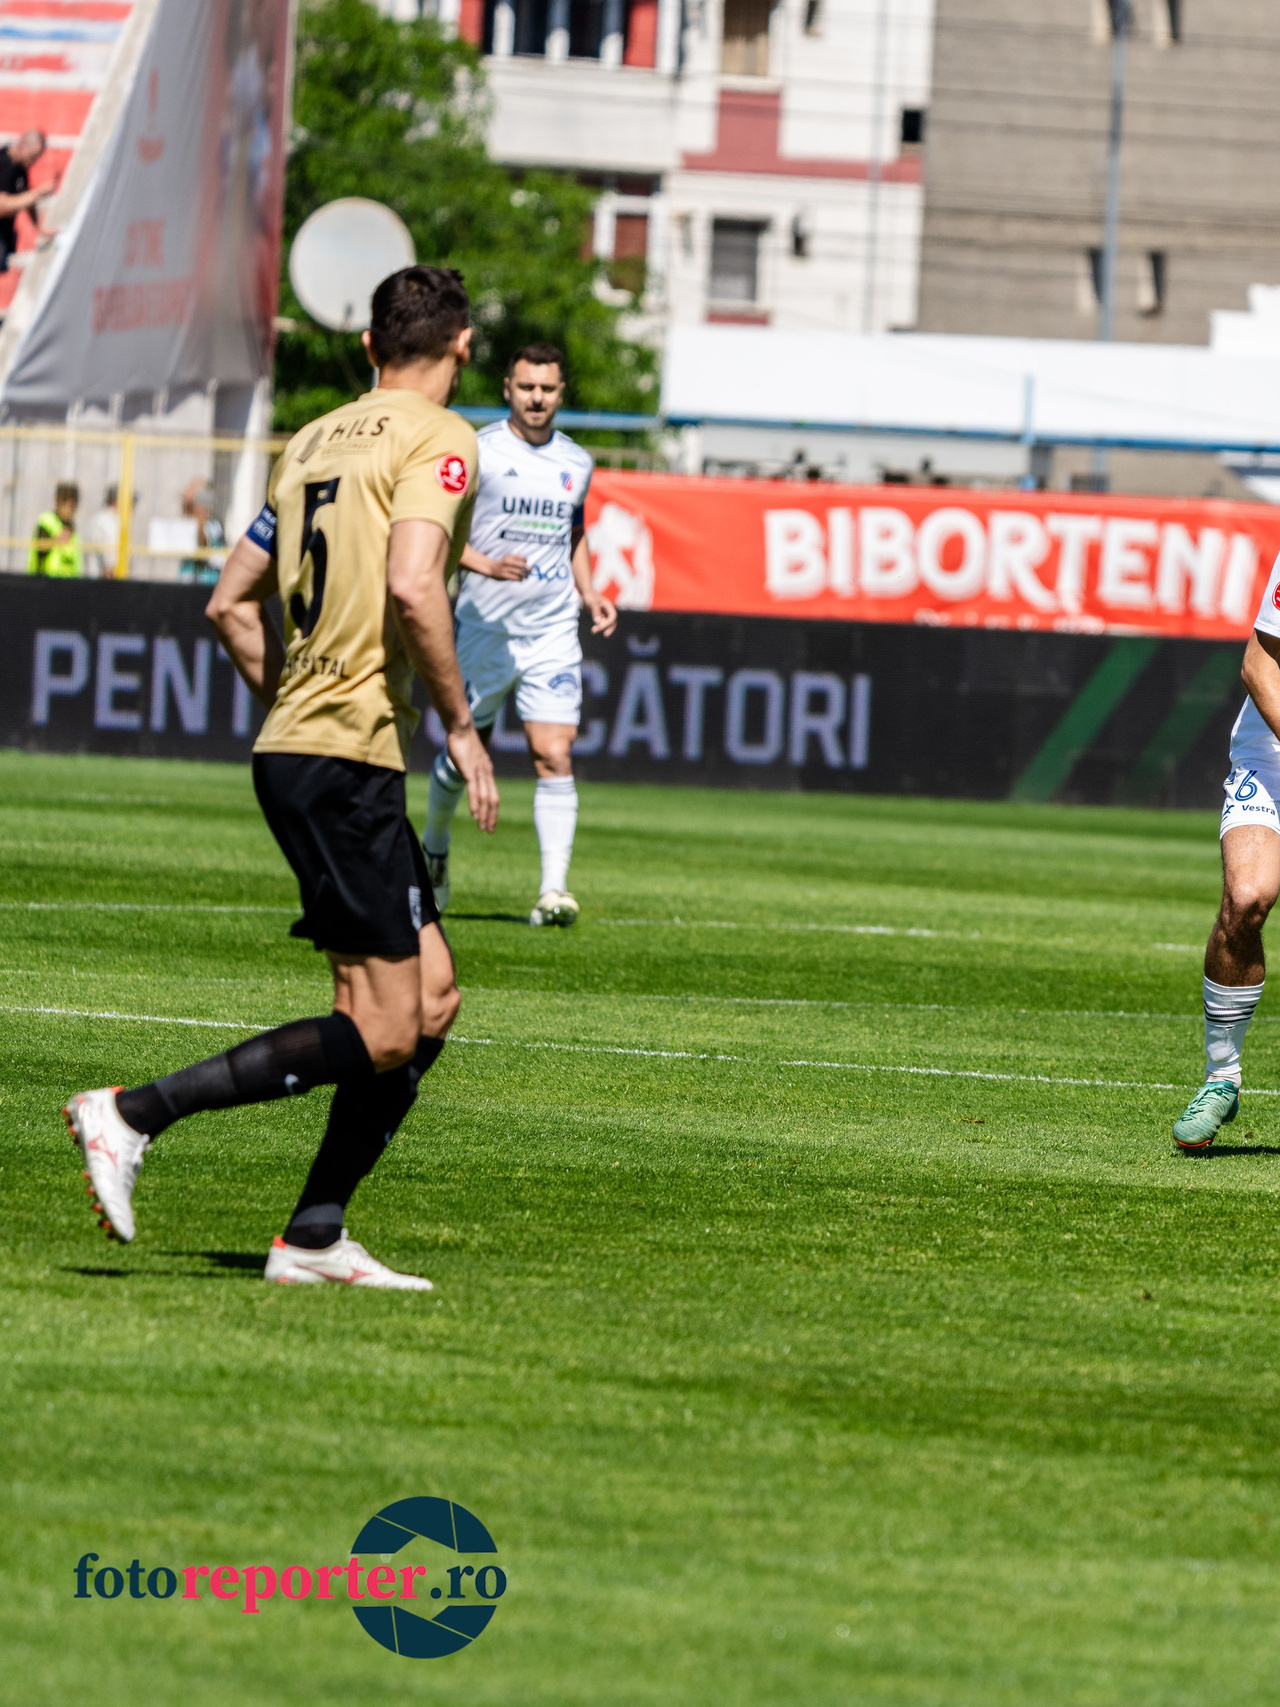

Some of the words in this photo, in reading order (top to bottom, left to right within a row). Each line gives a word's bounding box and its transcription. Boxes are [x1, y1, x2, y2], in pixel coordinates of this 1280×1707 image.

[328, 415, 391, 442] HILS
[288, 476, 342, 640] 5
[32, 629, 253, 738] PENT
[1242, 804, 1276, 816] Vestra
